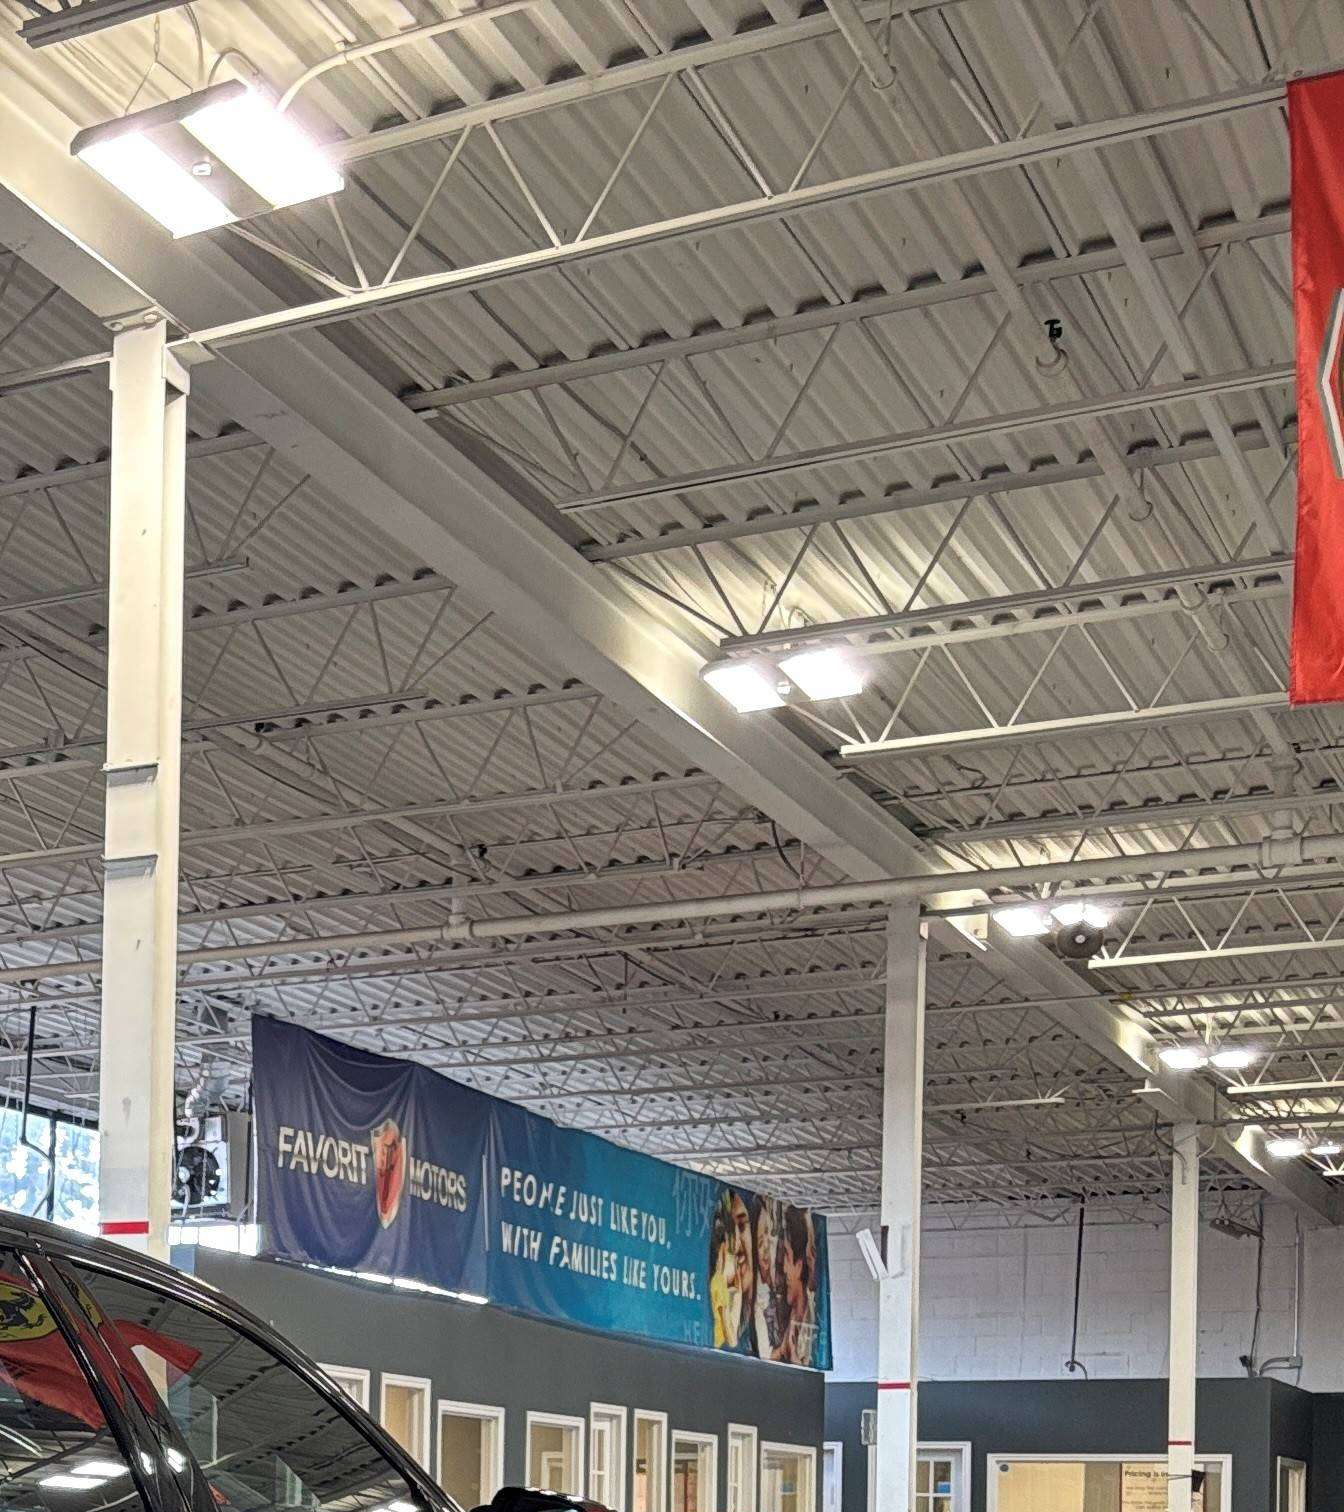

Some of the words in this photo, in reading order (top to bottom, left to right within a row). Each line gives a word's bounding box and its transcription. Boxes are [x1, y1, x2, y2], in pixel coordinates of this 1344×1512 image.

[278, 1126, 369, 1185] FAVORIT
[410, 1157, 467, 1212] MOTORS
[569, 1190, 603, 1227] JUST
[610, 1201, 638, 1236] LIKE
[501, 1221, 542, 1262] WITH
[549, 1235, 618, 1281] FAMILIES
[623, 1255, 647, 1289] LIKE
[653, 1264, 702, 1300] YOURS.
